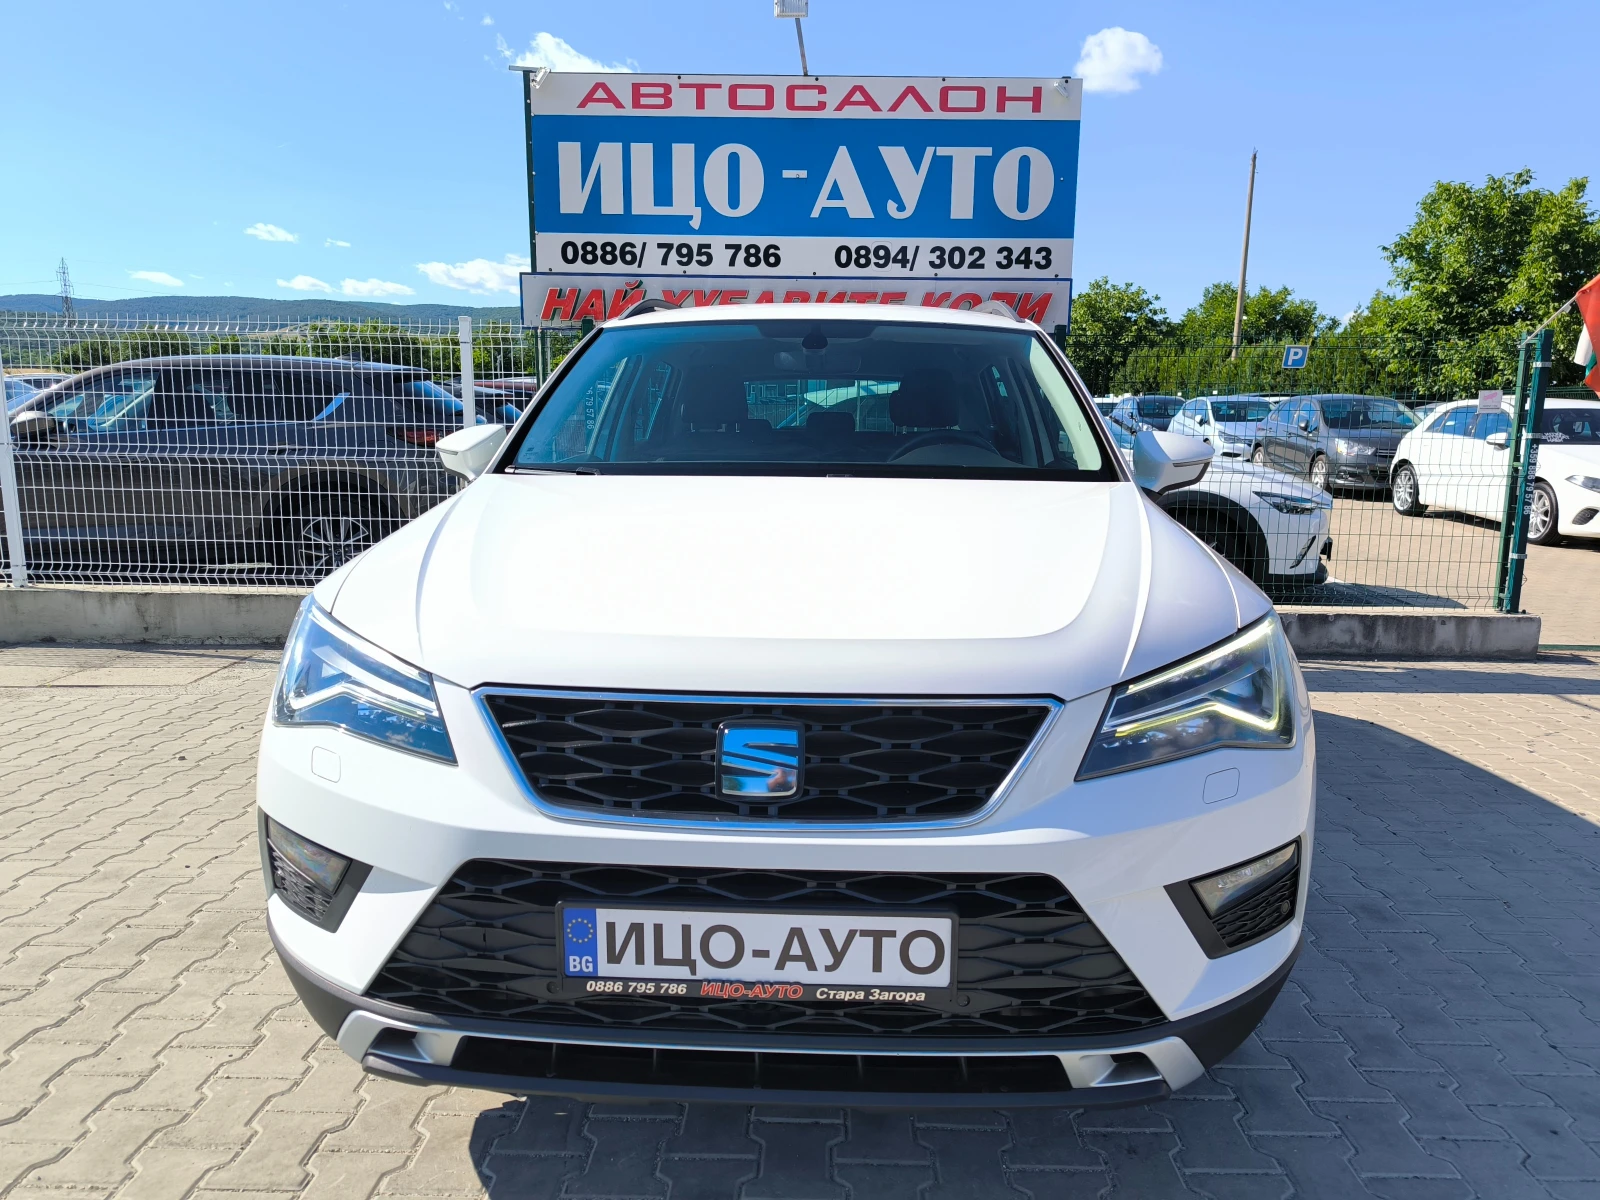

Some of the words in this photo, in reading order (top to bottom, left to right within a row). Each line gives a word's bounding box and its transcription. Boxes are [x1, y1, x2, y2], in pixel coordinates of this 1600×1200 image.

[576, 81, 1042, 114] АВТОСАЛОН
[561, 240, 647, 268] 0886/
[656, 242, 714, 267] 795
[724, 243, 782, 268] 786
[834, 244, 920, 271] 0894/
[928, 245, 986, 270] 302
[995, 246, 1053, 270] 343
[540, 279, 647, 321] НАЙ
[1287, 348, 1303, 366] P
[605, 921, 946, 976] ИЦО-АУТО
[568, 955, 594, 973] BG
[586, 980, 623, 993] 0886
[627, 982, 655, 994] 795
[660, 982, 687, 995] 786
[700, 981, 803, 999] ИЦО-АУТО
[816, 987, 865, 1001] Стара
[868, 988, 926, 1003] Загора
